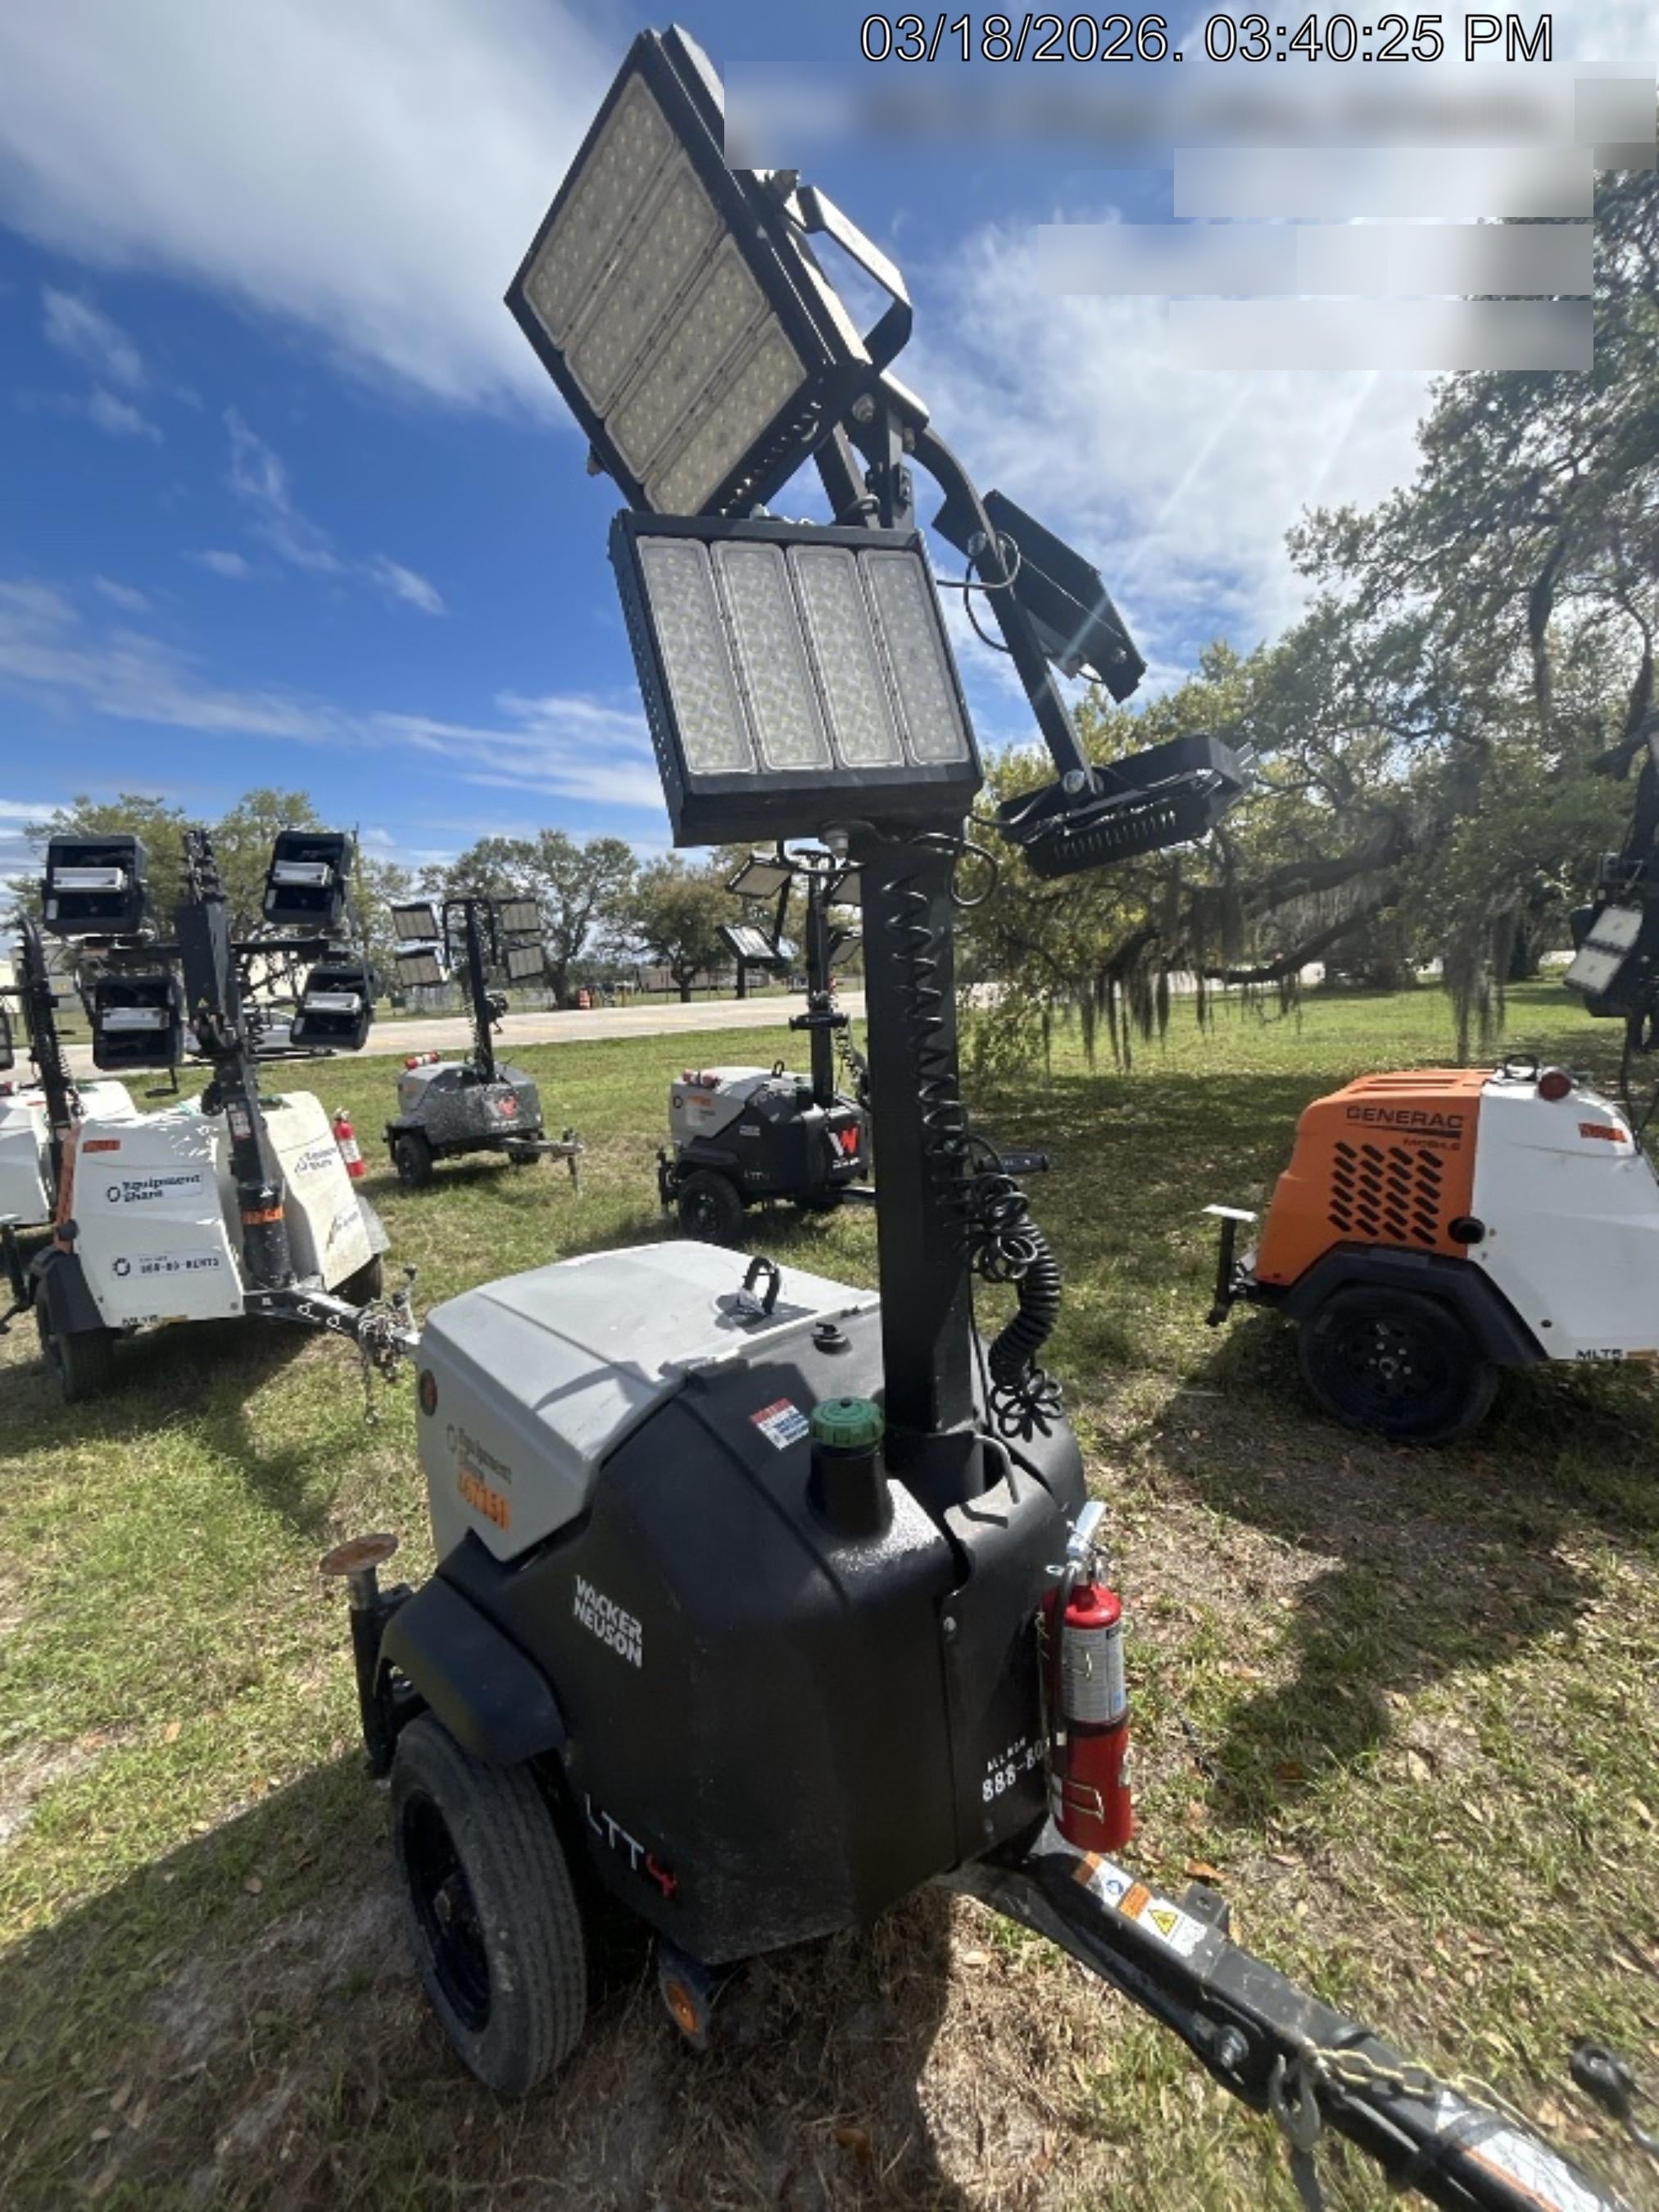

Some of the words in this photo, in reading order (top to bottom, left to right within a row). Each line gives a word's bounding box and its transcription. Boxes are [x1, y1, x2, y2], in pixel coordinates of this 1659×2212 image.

[1346, 1105, 1463, 1129] GENERAC
[573, 1596, 643, 1669] NEUSON
[575, 1574, 643, 1645] WACKER
